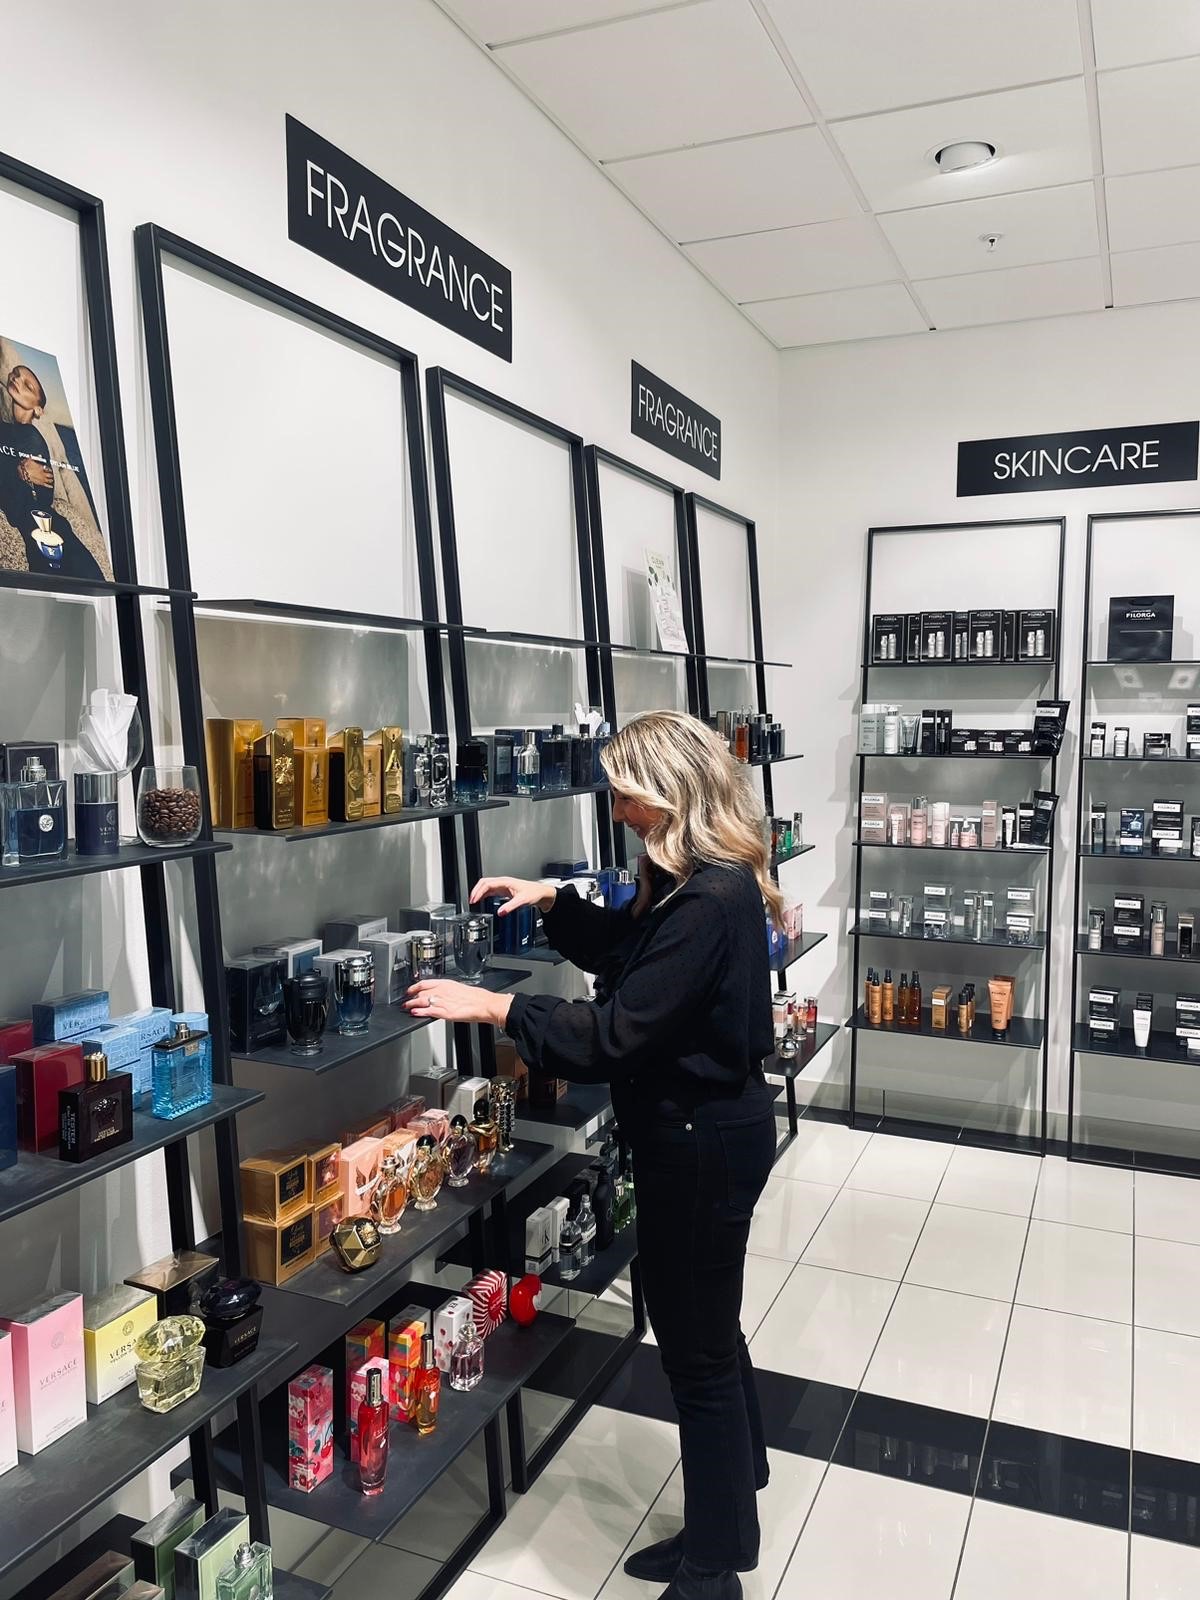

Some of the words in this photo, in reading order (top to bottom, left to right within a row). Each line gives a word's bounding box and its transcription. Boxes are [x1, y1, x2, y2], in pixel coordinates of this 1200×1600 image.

[306, 159, 504, 332] FRAGRANCE
[637, 383, 718, 462] FRAGRANCE
[993, 440, 1160, 480] SKINCARE
[140, 1026, 168, 1041] RSACE
[109, 1338, 138, 1360] VERSA
[39, 1359, 77, 1386] VERSACE
